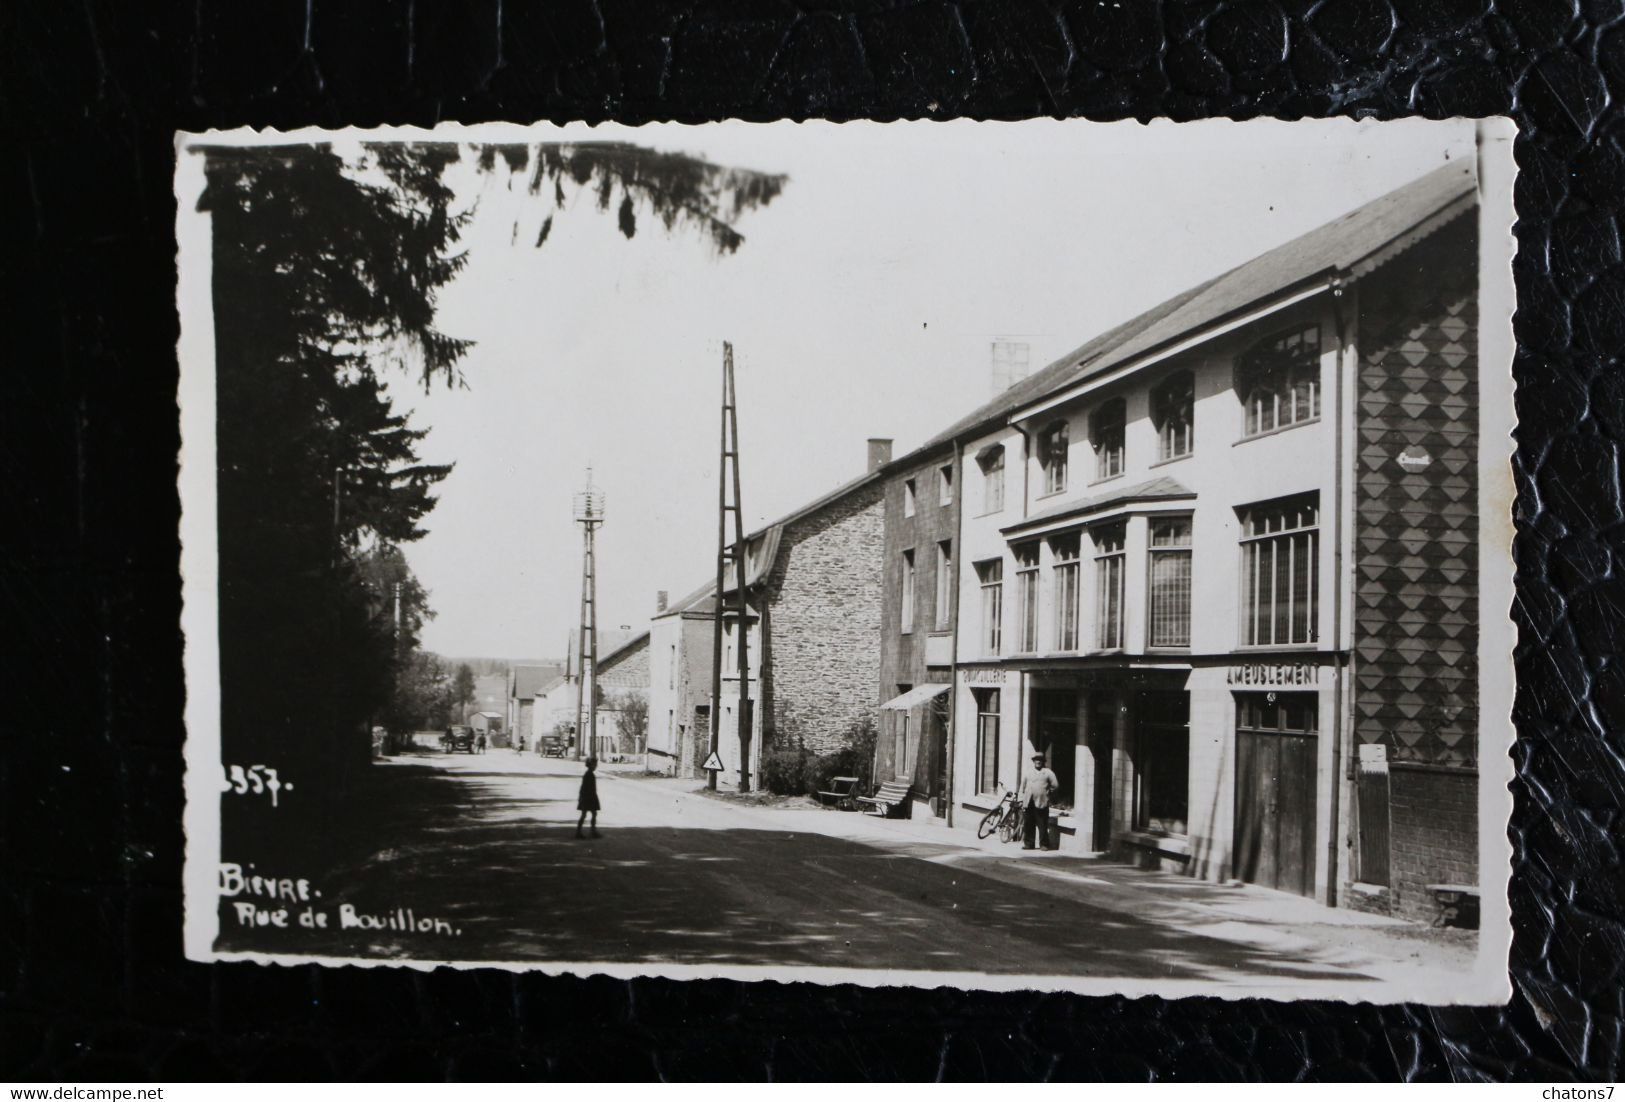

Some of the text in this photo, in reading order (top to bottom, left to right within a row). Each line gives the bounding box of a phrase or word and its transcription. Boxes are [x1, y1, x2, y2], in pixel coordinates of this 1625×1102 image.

[1227, 663, 1320, 685] AMEUBLEMENT
[232, 901, 289, 929] Rue
[298, 905, 328, 929] de
